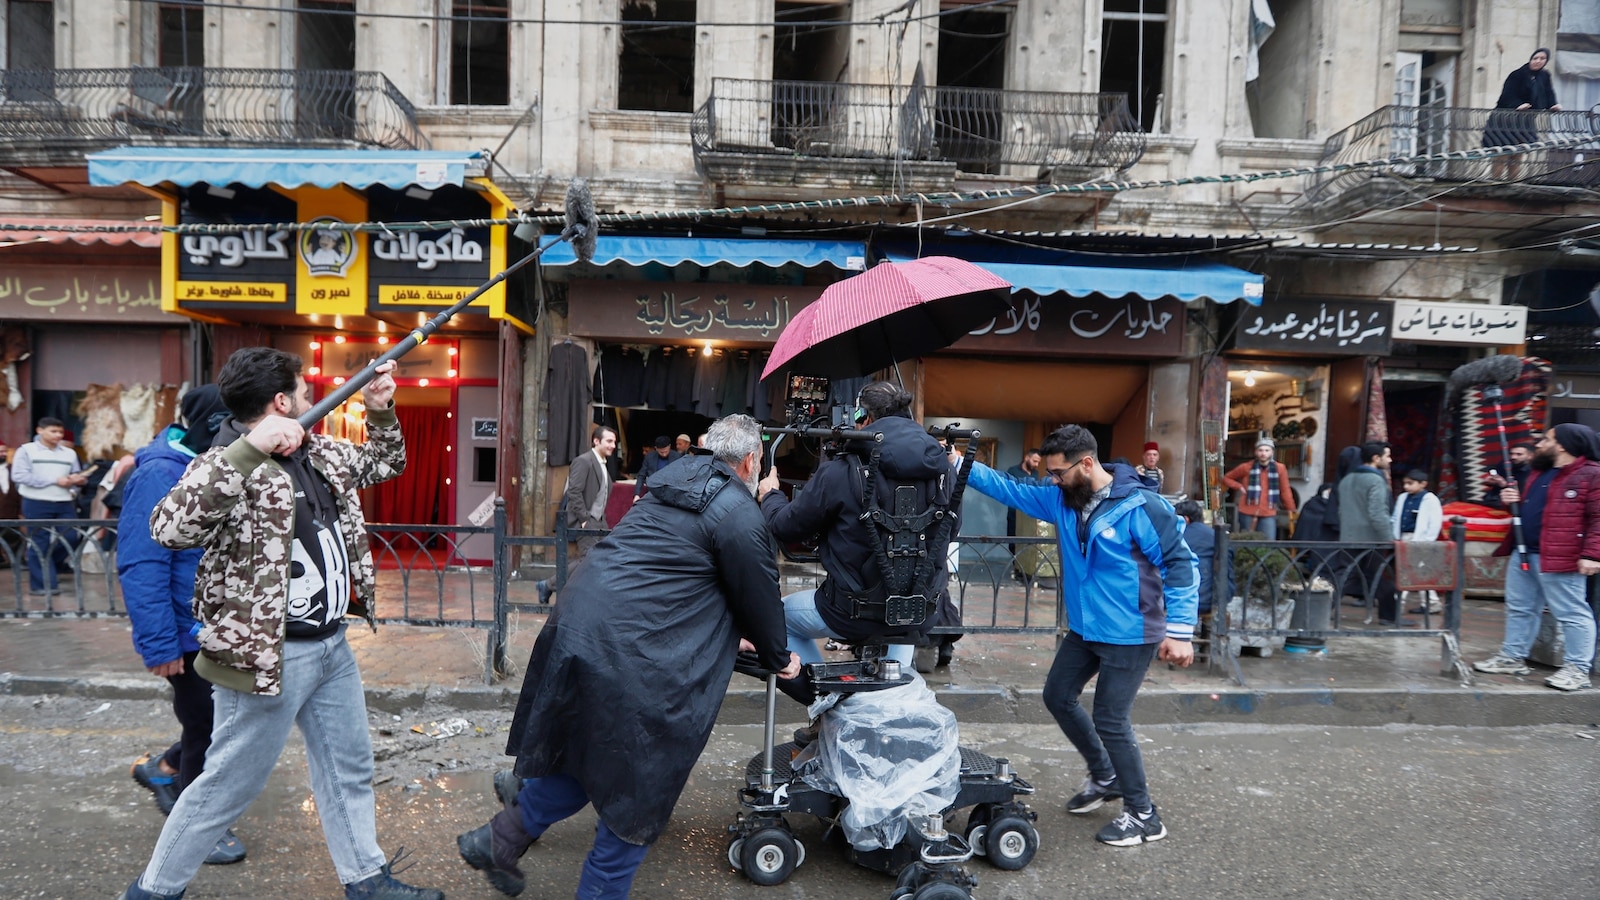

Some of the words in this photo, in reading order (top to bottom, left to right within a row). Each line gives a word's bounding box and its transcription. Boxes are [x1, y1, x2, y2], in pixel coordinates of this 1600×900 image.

[183, 229, 289, 267] كلاوي
[373, 227, 482, 270] مأكولات
[24, 277, 89, 314] باب
[95, 277, 166, 314] لديات
[392, 290, 420, 302] فلافل
[636, 291, 713, 335] رجالية
[1069, 301, 1173, 339] حلويات
[1244, 312, 1299, 340] عبدو
[1292, 303, 1327, 341] أبو
[1319, 309, 1386, 347] شرقيات
[1451, 311, 1519, 336] منسوجات
